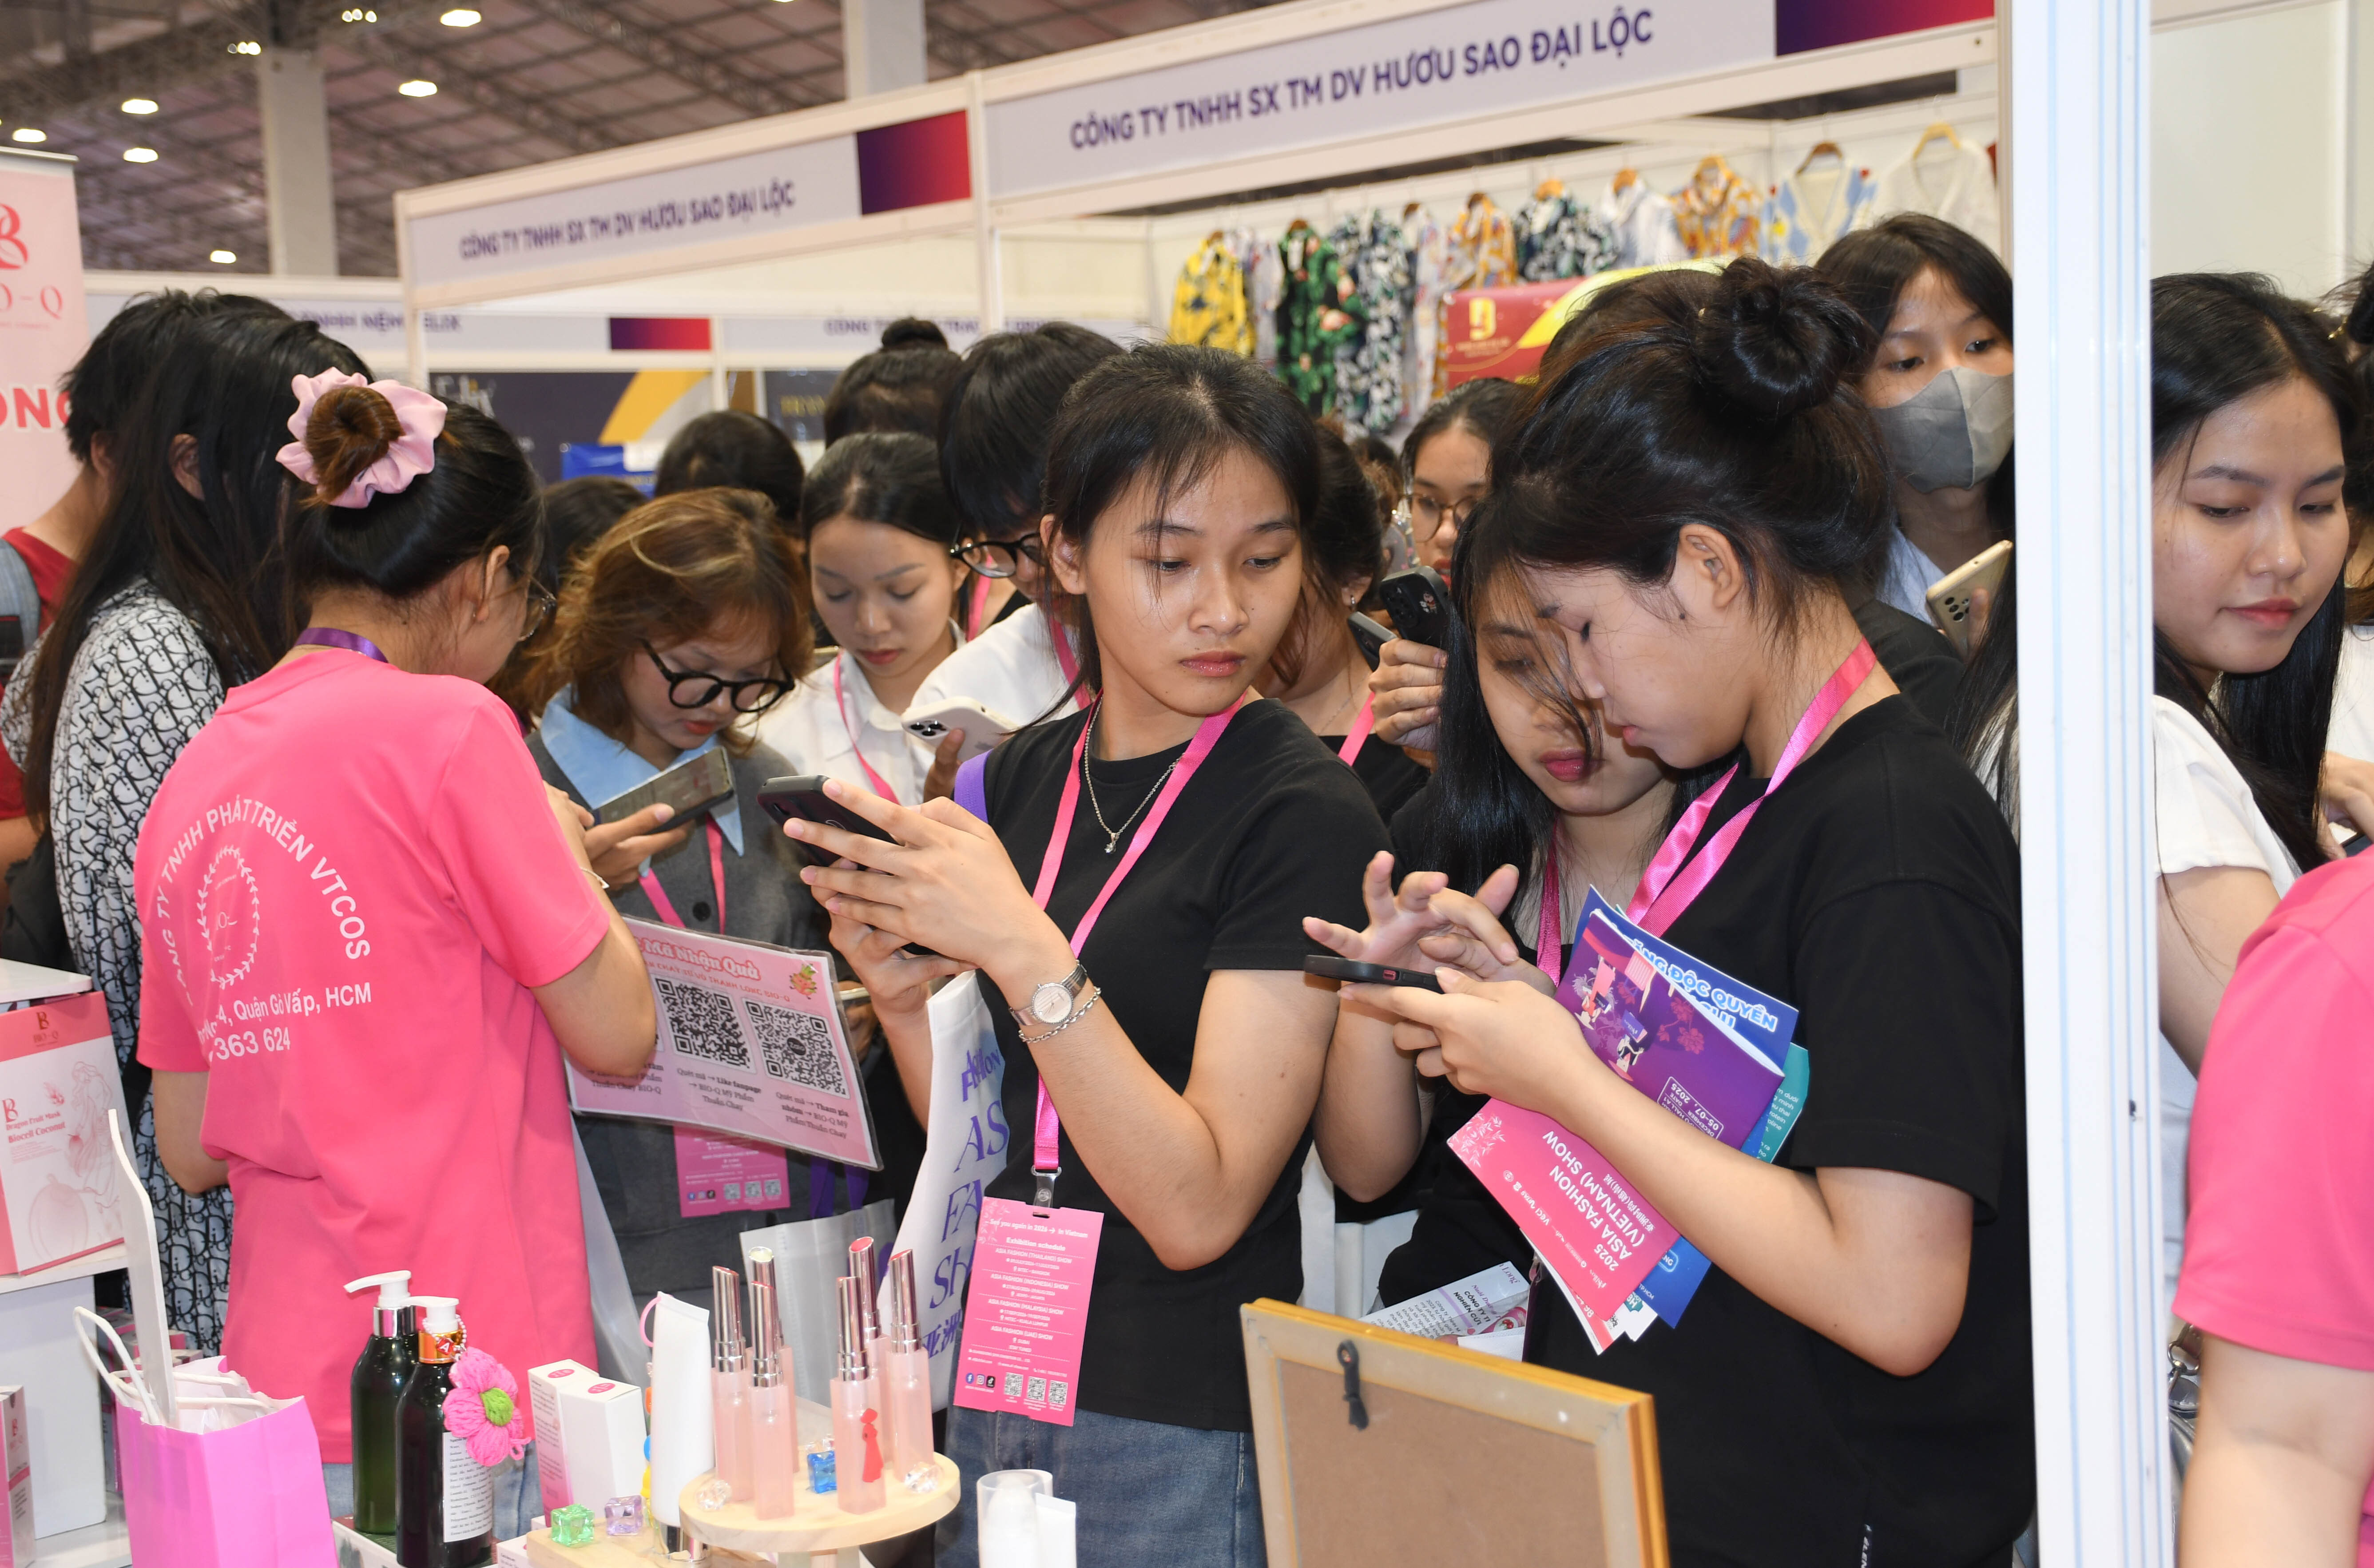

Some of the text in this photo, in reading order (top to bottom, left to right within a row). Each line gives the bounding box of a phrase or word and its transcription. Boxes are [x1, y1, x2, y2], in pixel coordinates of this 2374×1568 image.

[1069, 4, 1654, 150] CÔNG TY TNHH SX TM DV HƯƠU SAO ĐẠI LỘC
[460, 229, 500, 259] CÔNG
[502, 227, 520, 252] TY
[522, 222, 564, 250] TNHH
[567, 218, 588, 244] SX
[589, 214, 611, 239] TM
[614, 210, 635, 237] DV
[690, 193, 724, 225] SAO
[726, 188, 759, 223] ĐẠI
[761, 176, 796, 217] LỘC
[157, 794, 371, 960] TY TNHH PHÁT TRIỂN VTCOS
[644, 938, 674, 959] Mã
[674, 945, 724, 972] Nhận
[722, 956, 762, 981] Quà
[1667, 963, 1712, 998] ĐỘC
[233, 982, 372, 1022] Quận Gò Vấp, HCM
[262, 1026, 291, 1052] 624
[716, 1076, 733, 1087] Like
[733, 1079, 762, 1094] fanpage
[1670, 1083, 1691, 1104] 2025
[726, 1100, 744, 1111] Chay
[1669, 1092, 1683, 1107] DATE
[1778, 1098, 1794, 1110] minh
[1784, 1092, 1799, 1103] dưới
[781, 1104, 804, 1115] nhóm
[814, 1102, 838, 1114] Tham
[1671, 1103, 1685, 1119] HALL
[1778, 1107, 1790, 1117] thai
[5, 1117, 29, 1131] Dragon
[29, 1114, 44, 1126] Fruit
[8, 1121, 66, 1144] Biocell Coconut
[1687, 1109, 1715, 1137] DECEMBER
[1542, 1130, 1646, 1247] (VIETNAM) SHOW
[1549, 1164, 1604, 1229] FASHION
[1000, 1220, 1012, 1229] you
[1012, 1222, 1027, 1231] again
[1064, 1229, 1088, 1239] Vietnam
[1005, 1236, 1066, 1252] Exhibition schedule
[1601, 1223, 1632, 1260] ASIA
[1007, 1249, 1029, 1258] FASHION
[1028, 1251, 1057, 1262] (THAILAND)
[1593, 1243, 1620, 1272] 2025
[1002, 1274, 1024, 1283] FASHION
[1023, 1278, 1053, 1288] (INDONESIA)
[1000, 1300, 1021, 1309] FASHION
[1453, 1291, 1472, 1314] NGHIÊN
[1464, 1290, 1488, 1318] CÔNG TY
[1002, 1327, 1024, 1335] FASHION
[1024, 1330, 1038, 1338] (UAE)
